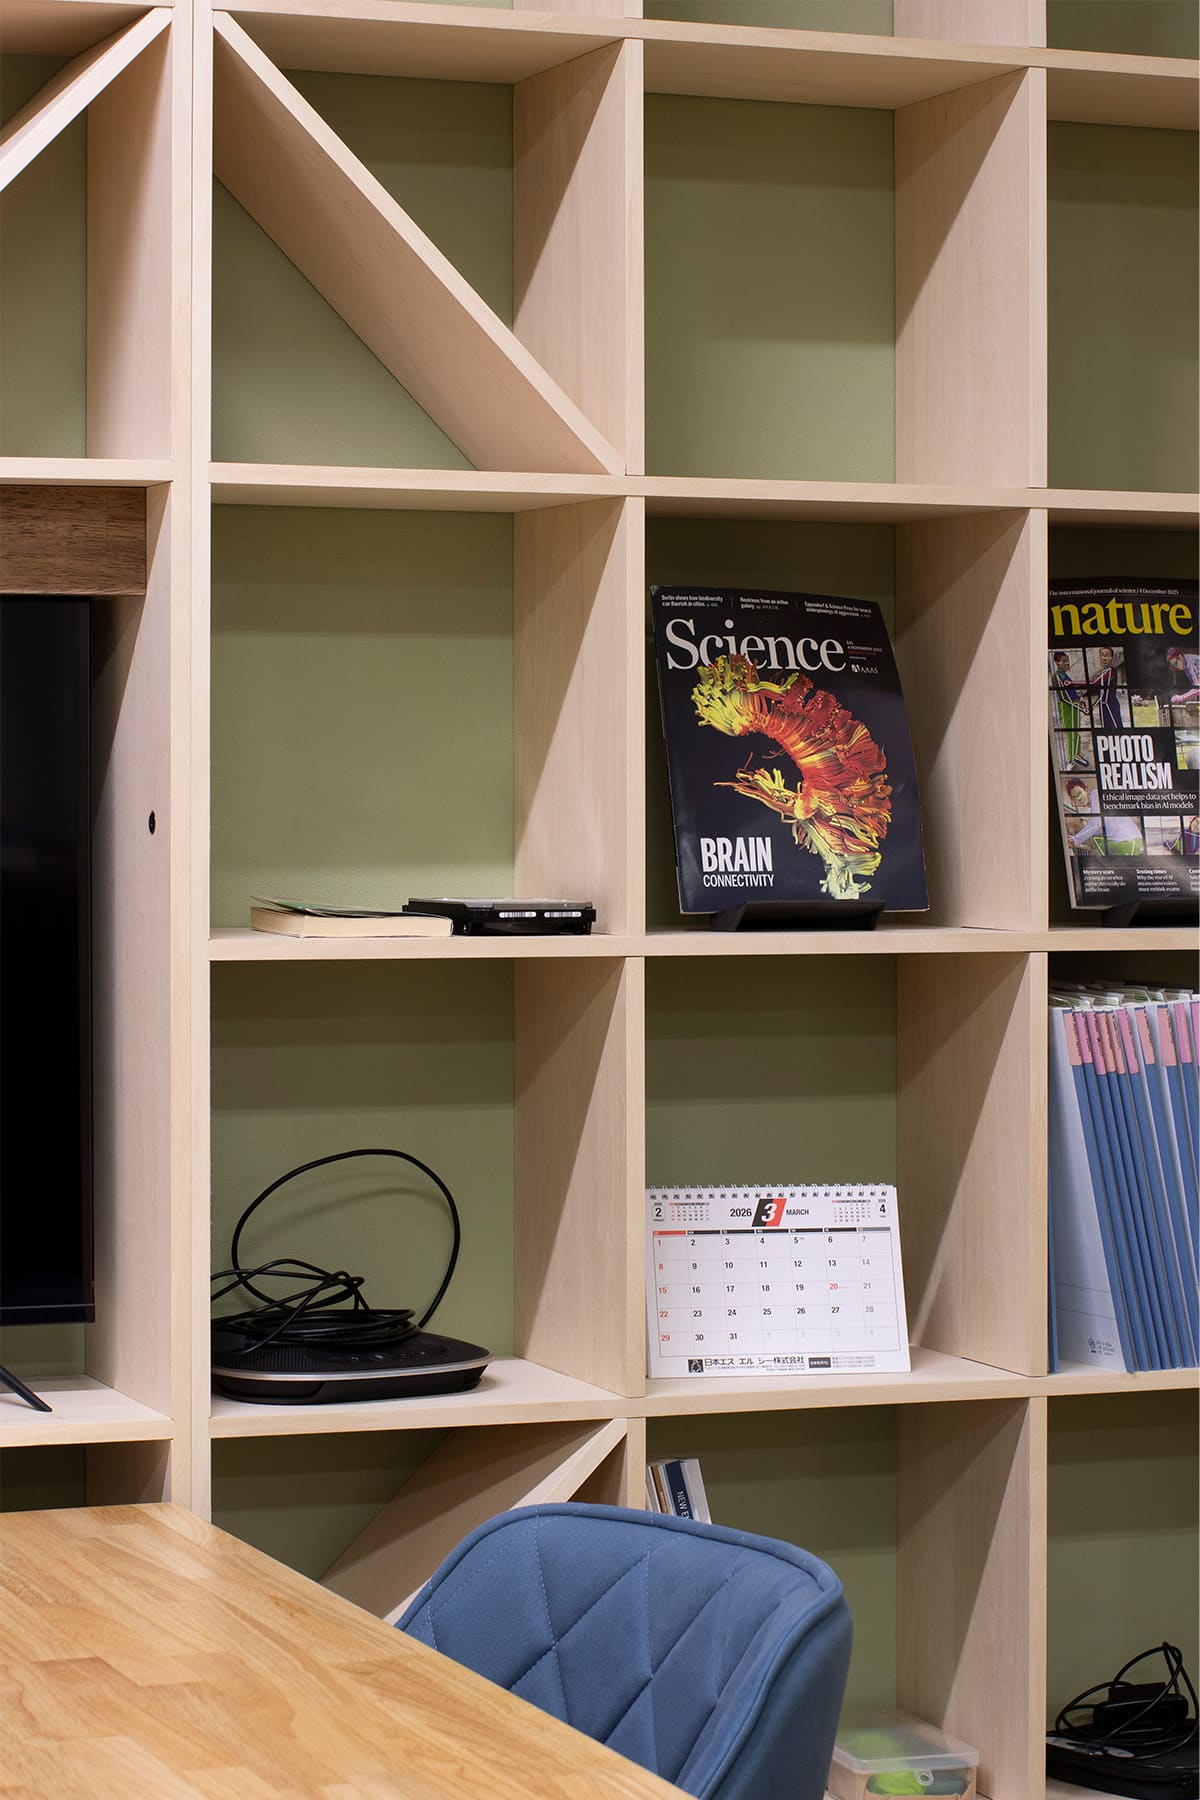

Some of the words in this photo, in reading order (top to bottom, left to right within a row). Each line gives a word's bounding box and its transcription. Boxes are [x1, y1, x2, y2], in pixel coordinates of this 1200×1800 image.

[1093, 588, 1112, 596] journal
[1051, 597, 1193, 636] nature
[665, 618, 846, 672] Science
[1096, 735, 1154, 762] PHOTO
[1100, 762, 1173, 790] REALISM
[1102, 793, 1125, 801] Ethical
[1125, 794, 1146, 802] image
[1171, 793, 1189, 801] helps
[1169, 801, 1194, 809] models
[700, 837, 773, 872] BRAIN
[703, 874, 774, 887] CONNECTIVITY
[655, 1207, 662, 1217] 2
[729, 1208, 752, 1217] 2026
[761, 1202, 777, 1222] 3
[879, 1204, 886, 1214] 4
[676, 1491, 688, 1510] NEW
